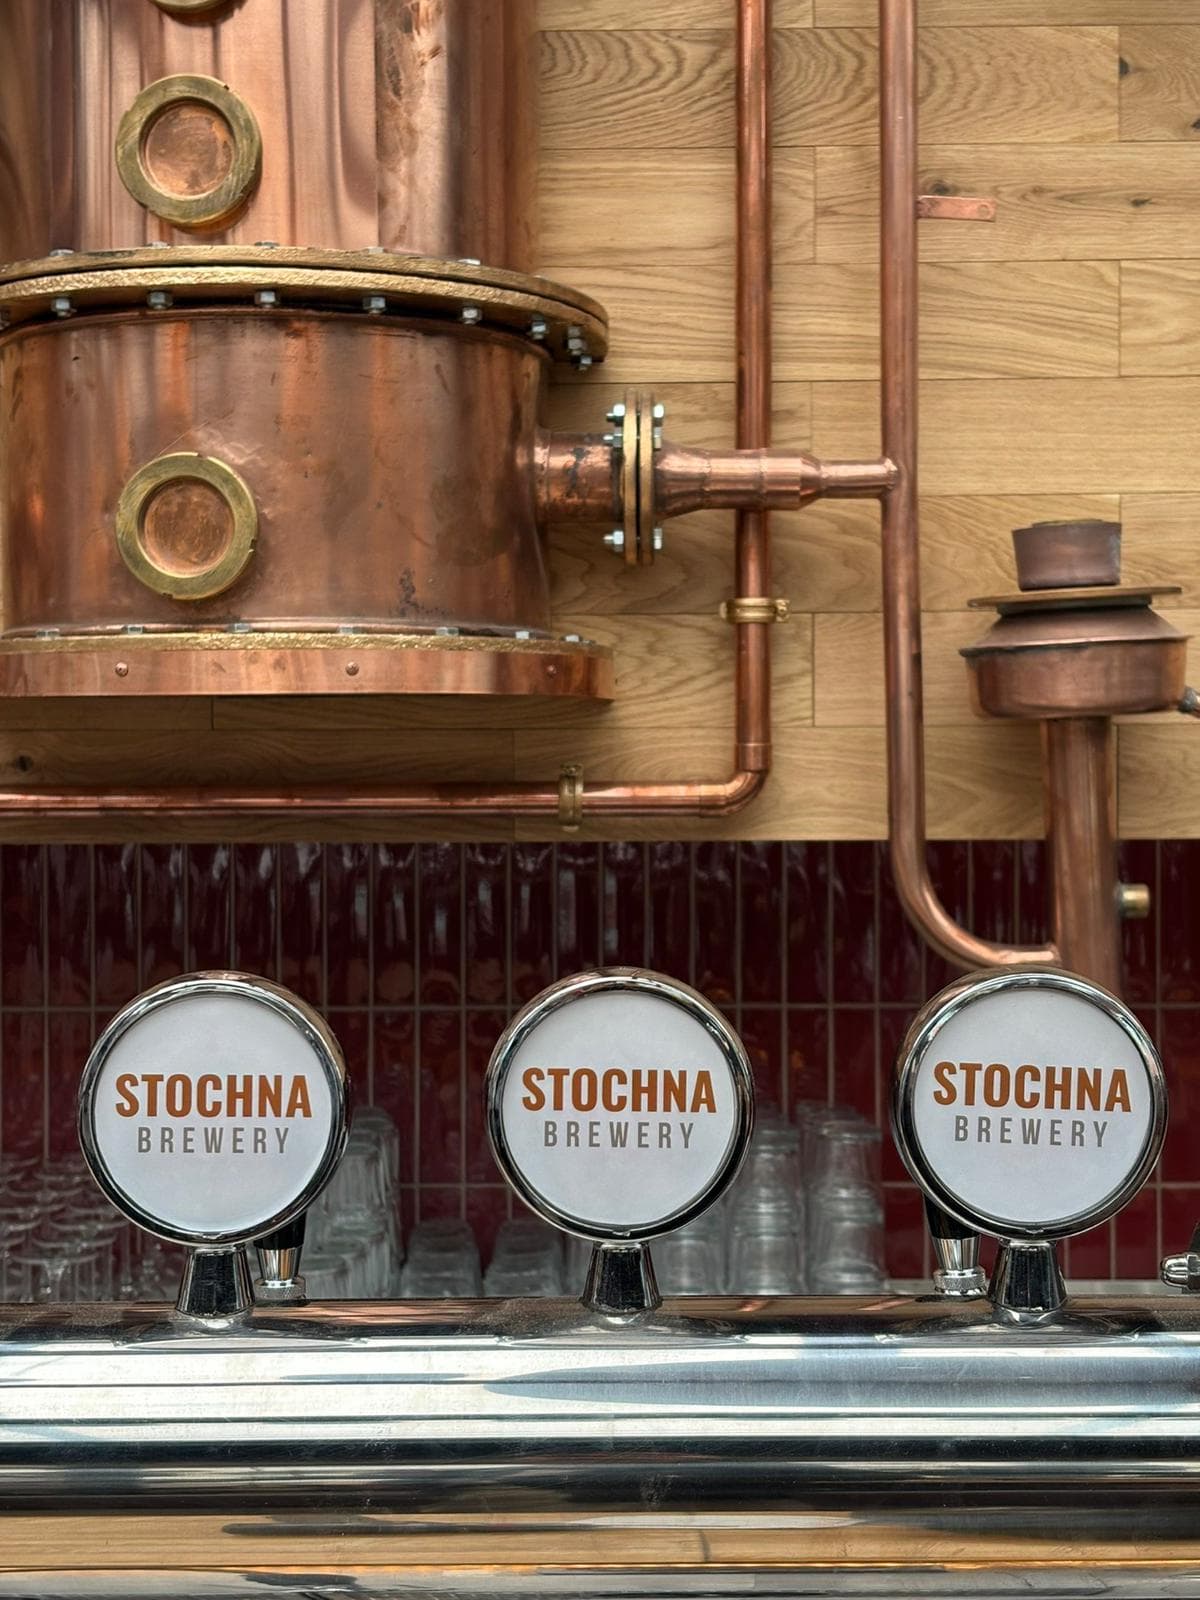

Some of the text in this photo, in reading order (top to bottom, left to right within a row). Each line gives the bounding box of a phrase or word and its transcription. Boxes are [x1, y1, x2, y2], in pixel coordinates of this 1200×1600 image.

[115, 1074, 313, 1118] STOCHNA
[521, 1068, 717, 1113] STOCHNA
[933, 1062, 1132, 1112] STOCHNA
[138, 1127, 289, 1154] BREWERY
[544, 1121, 694, 1149] BREWERY
[955, 1116, 1108, 1147] BREWERY
